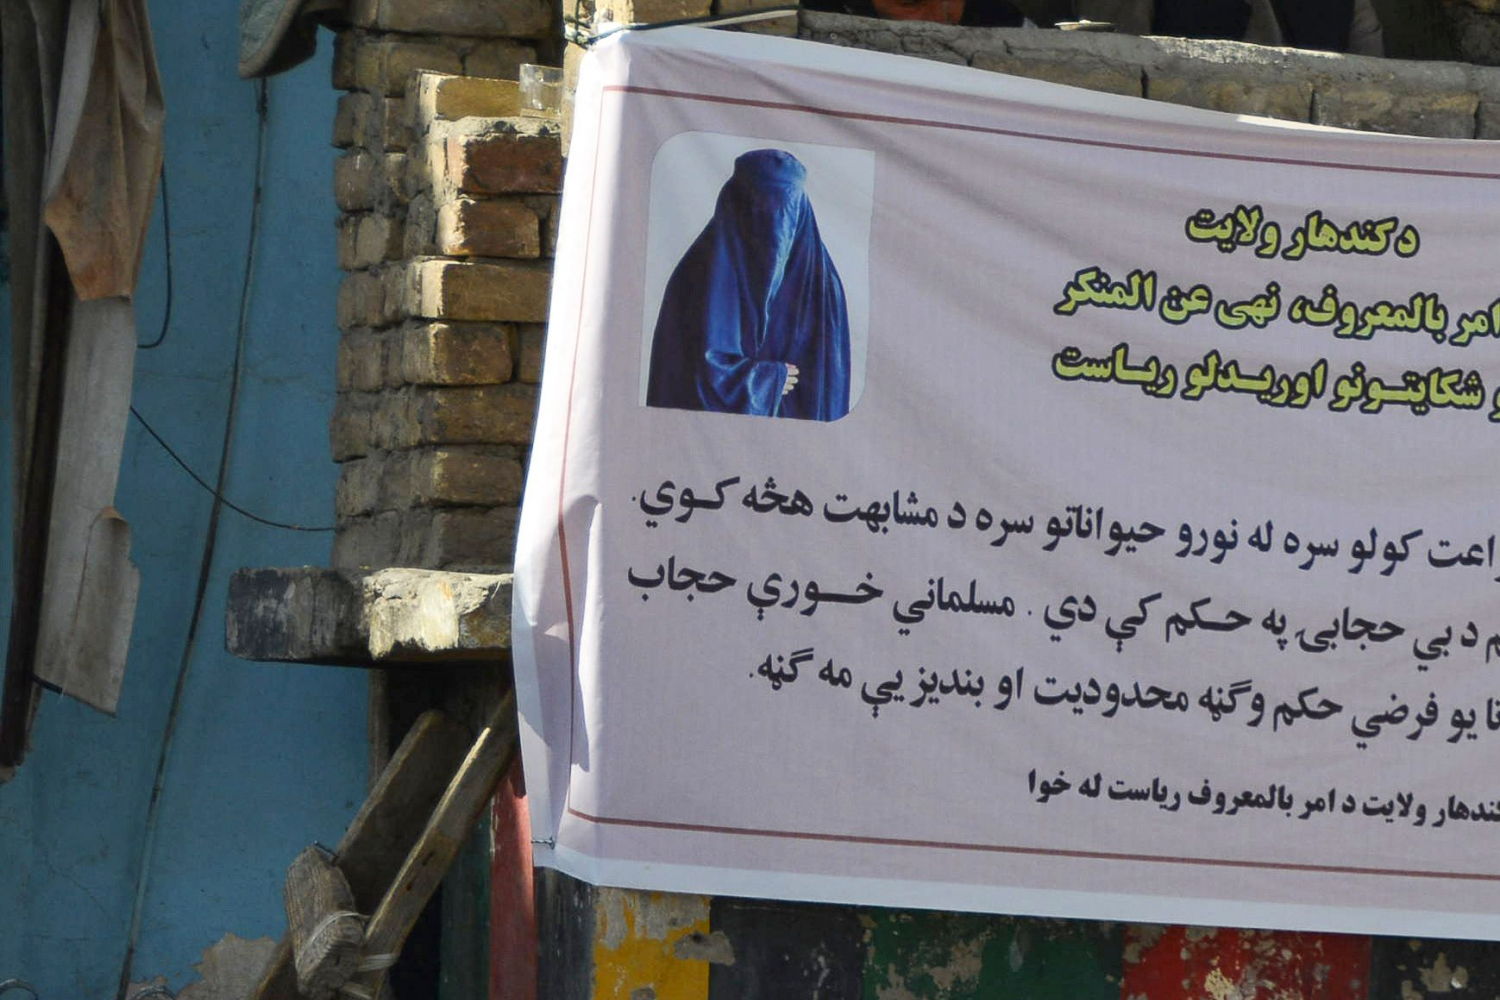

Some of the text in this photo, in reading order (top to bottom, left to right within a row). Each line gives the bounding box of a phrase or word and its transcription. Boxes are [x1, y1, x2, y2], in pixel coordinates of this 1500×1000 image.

[1185, 204, 1420, 261] د کندهار ولایت
[1053, 266, 1157, 316] المنکر
[1159, 284, 1213, 325] عن
[1051, 342, 1178, 399] ریاست
[823, 489, 939, 535] مشابهت
[947, 501, 967, 529] د
[975, 507, 1034, 548] سره
[1174, 518, 1239, 565] نورو
[1247, 519, 1274, 553] له
[1283, 531, 1340, 571] سره
[1347, 527, 1424, 577] کولو
[627, 555, 738, 602] حجاب
[1165, 596, 1253, 644] حکم
[1261, 608, 1289, 652] په
[1460, 621, 1479, 648] د
[818, 658, 853, 689] مه
[993, 666, 1024, 711] او
[1272, 686, 1344, 733] حکم
[1446, 708, 1478, 744] یو
[1027, 768, 1072, 804] خوا
[1078, 772, 1103, 799] له
[1107, 776, 1181, 812] ریاست
[1187, 778, 1294, 818] بالمعروف
[1297, 787, 1336, 821] امر
[1341, 794, 1357, 814] د
[1361, 791, 1427, 827] ولایت
